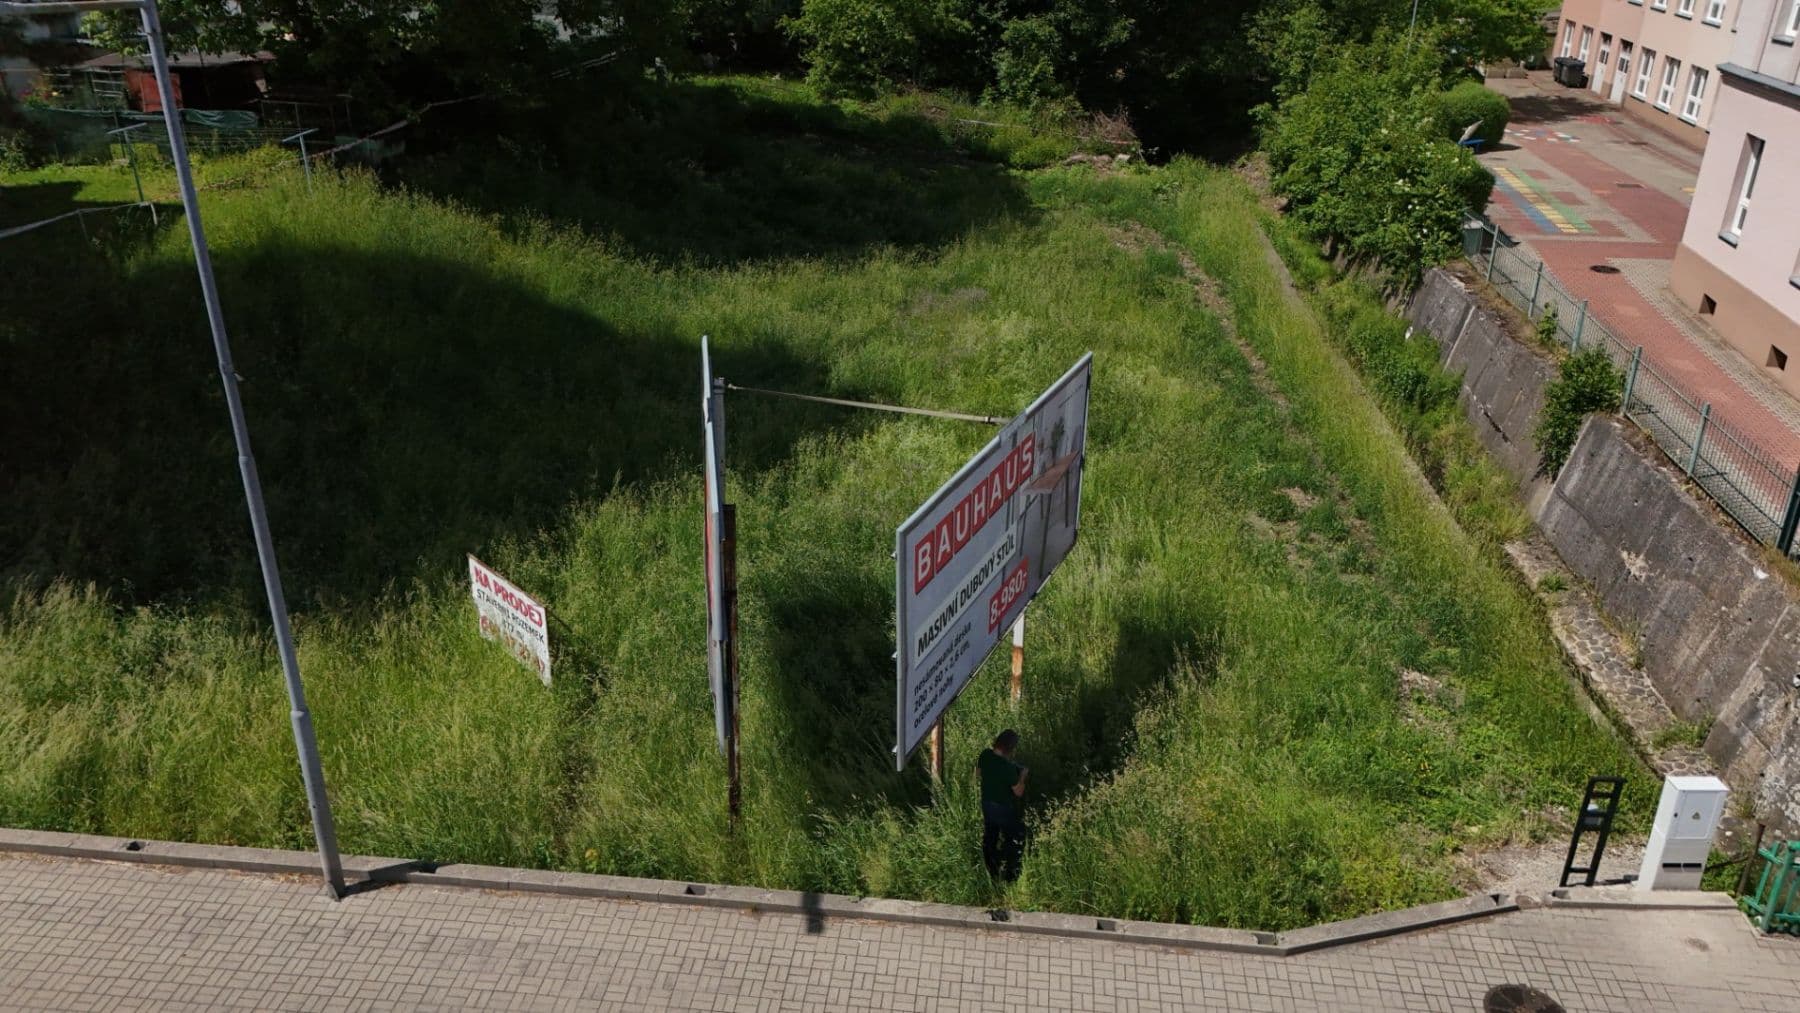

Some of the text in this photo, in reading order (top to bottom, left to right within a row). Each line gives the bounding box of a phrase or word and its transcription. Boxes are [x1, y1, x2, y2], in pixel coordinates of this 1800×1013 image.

[918, 439, 1033, 584] BAUHAUS
[917, 534, 1015, 657] MASIVNÍ DUBOVÝ STŮL
